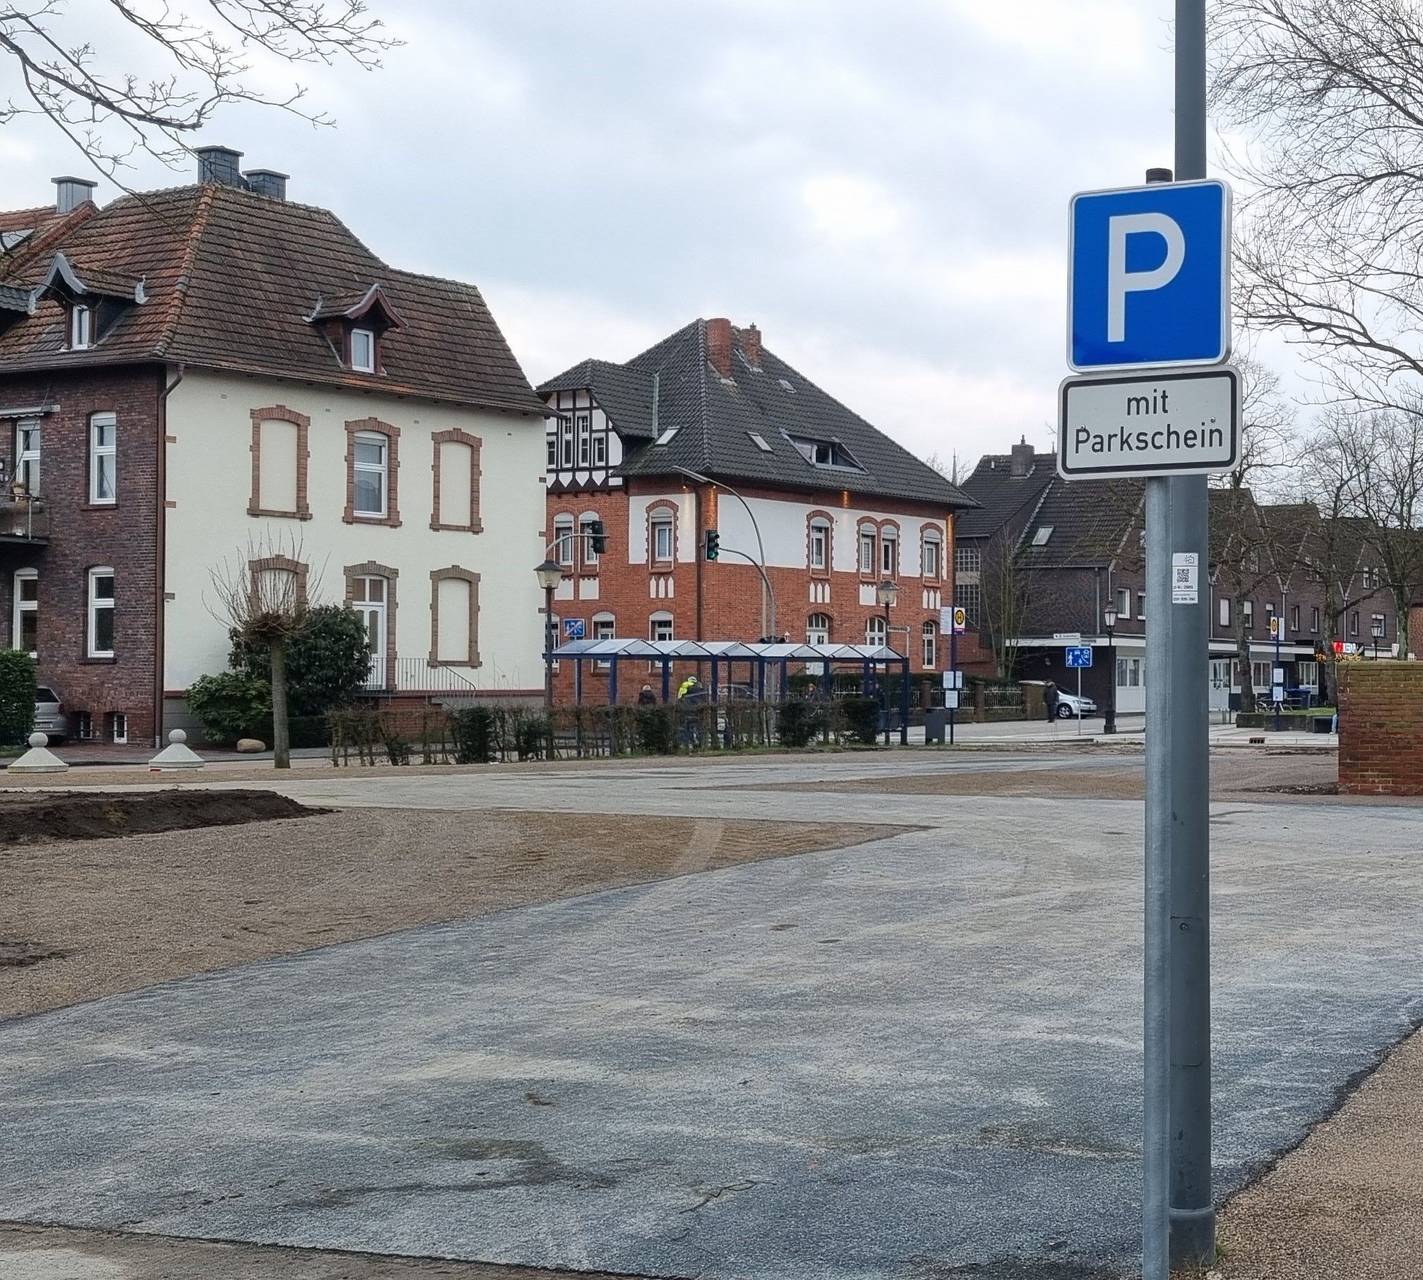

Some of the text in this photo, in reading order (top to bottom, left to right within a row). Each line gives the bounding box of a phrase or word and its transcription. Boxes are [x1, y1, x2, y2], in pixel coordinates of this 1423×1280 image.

[1107, 212, 1186, 343] P
[1126, 389, 1169, 416] mit
[1075, 422, 1223, 454] Parkschein
